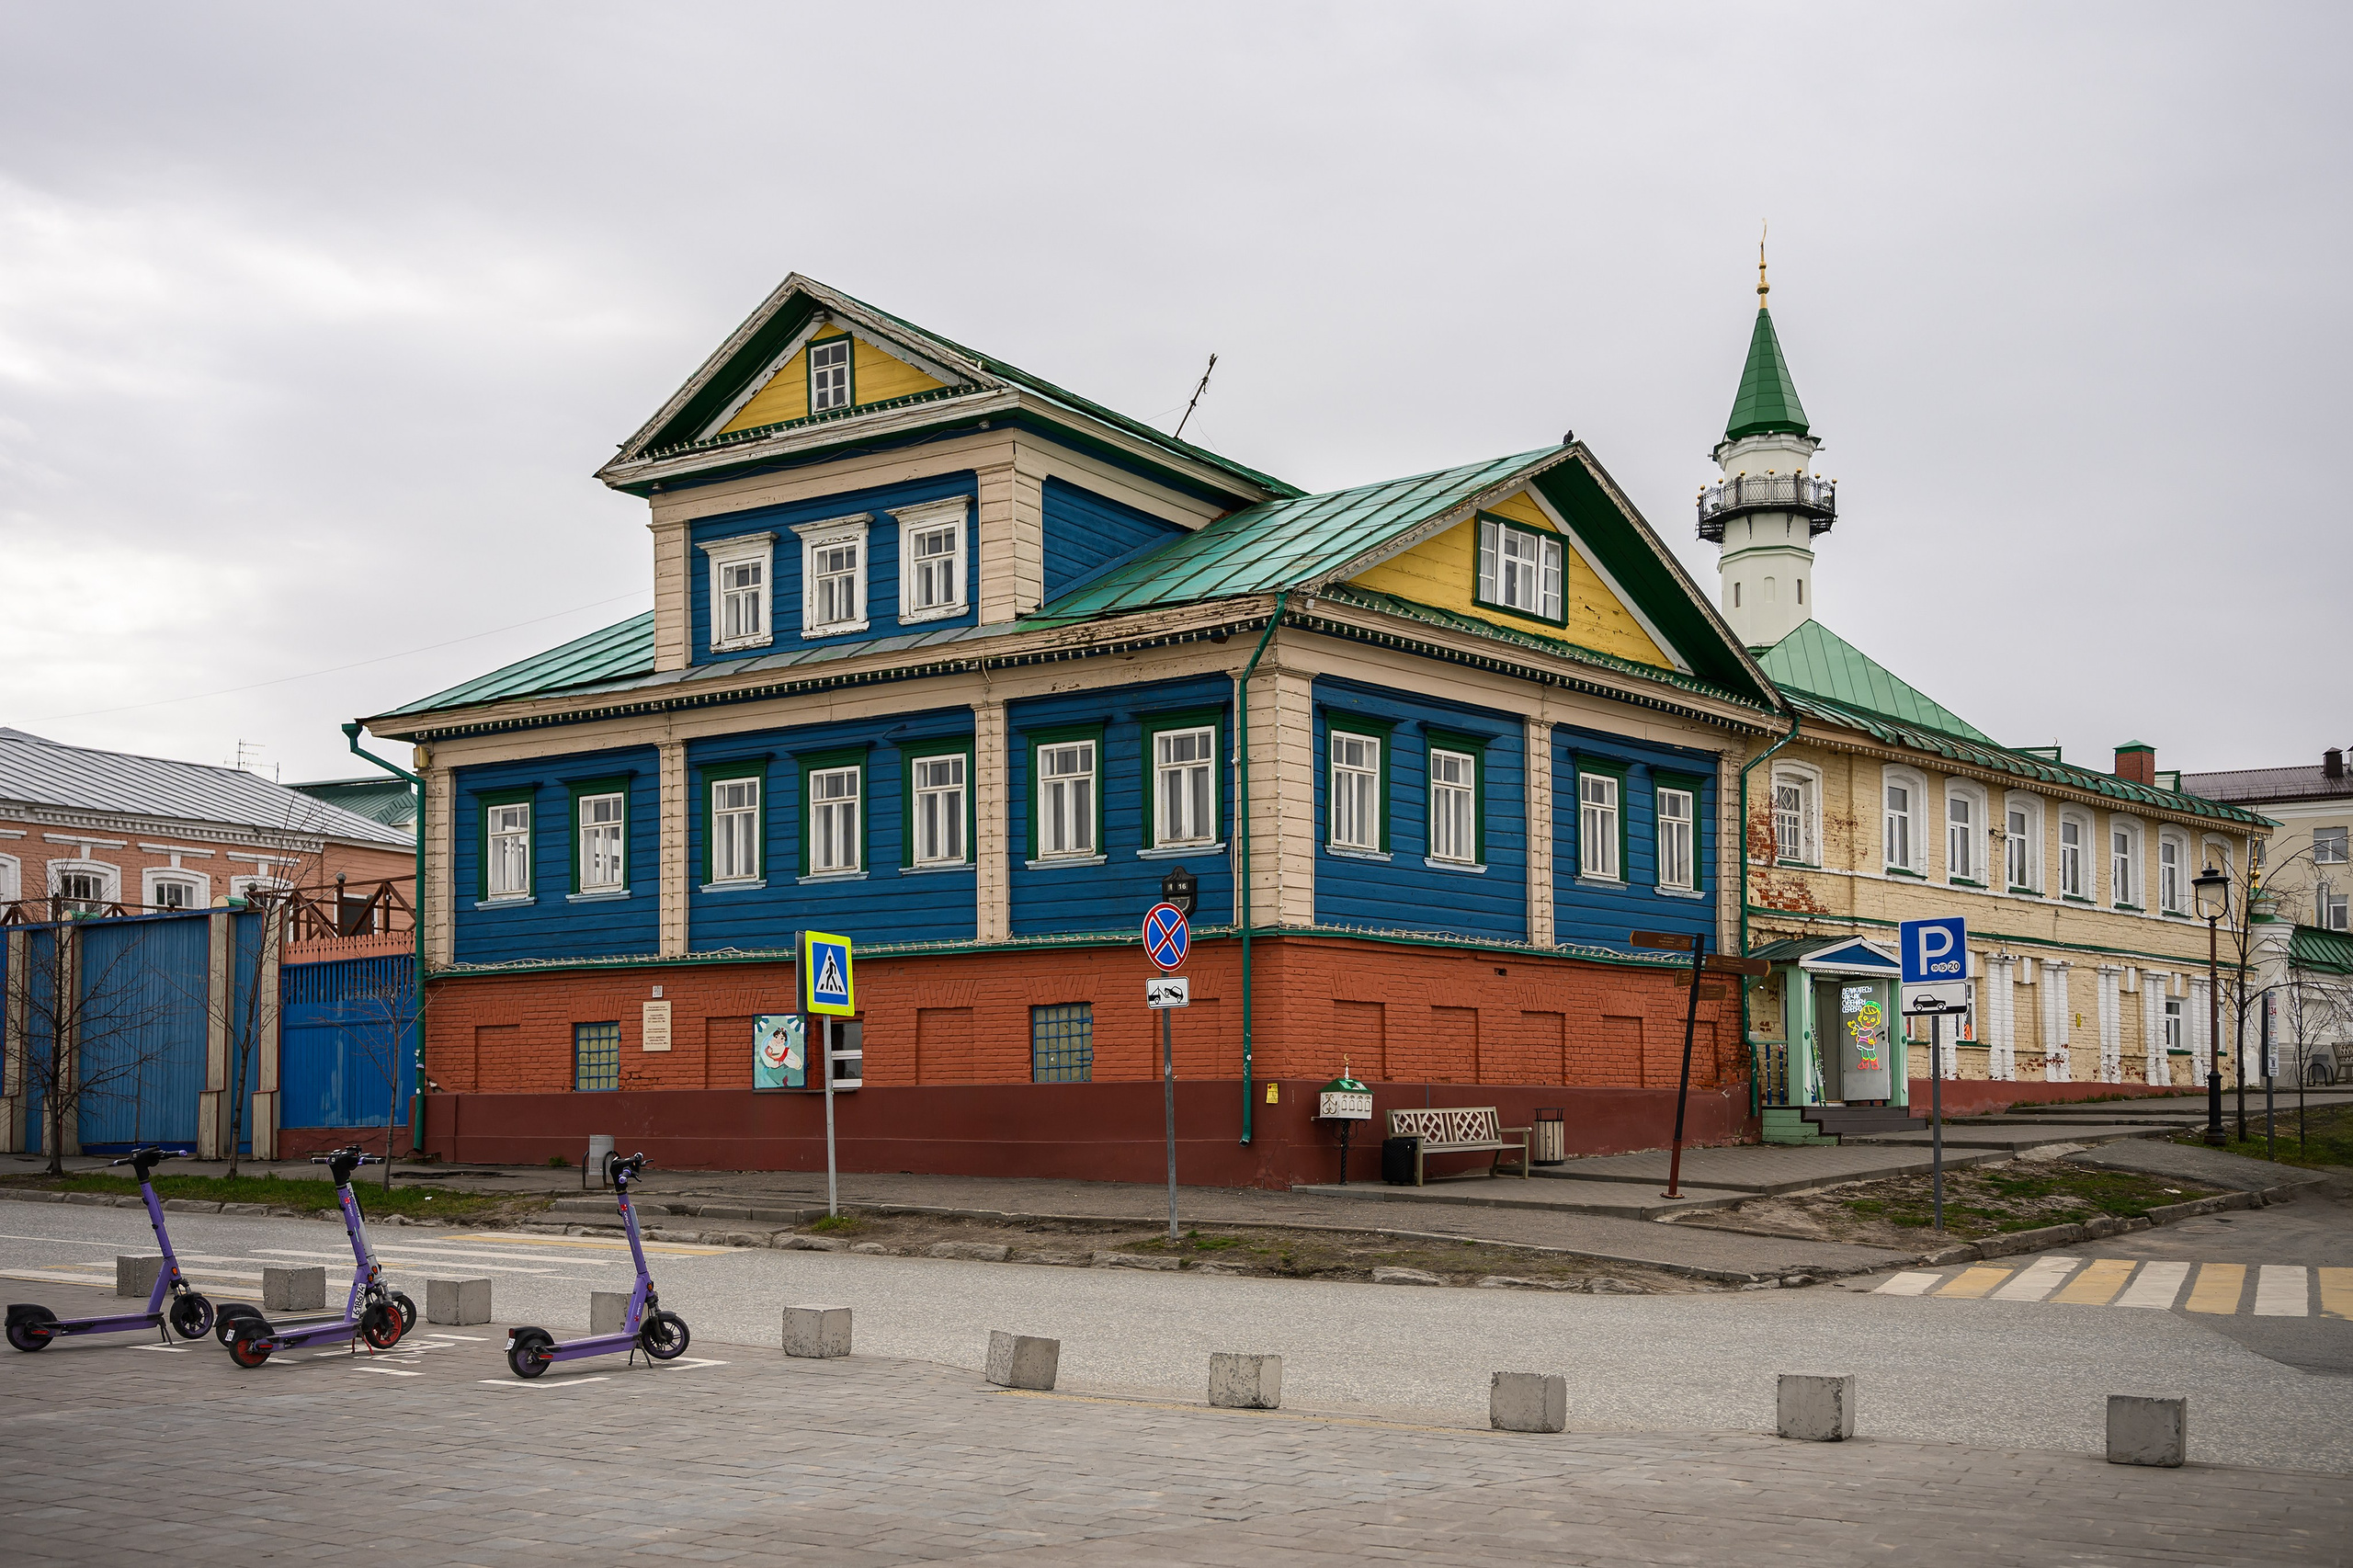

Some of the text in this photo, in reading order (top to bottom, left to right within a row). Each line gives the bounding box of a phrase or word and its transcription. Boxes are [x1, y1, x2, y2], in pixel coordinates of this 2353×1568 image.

[1918, 926, 1953, 975] P
[1949, 962, 1960, 971] 20
[1842, 985, 1872, 994] ДЕЛИКАТЕСЫ
[1841, 998, 1866, 1006] СУВЕНИРЫ
[1841, 1005, 1862, 1013] СЕРЕБРО
[353, 1287, 366, 1315] 618674
